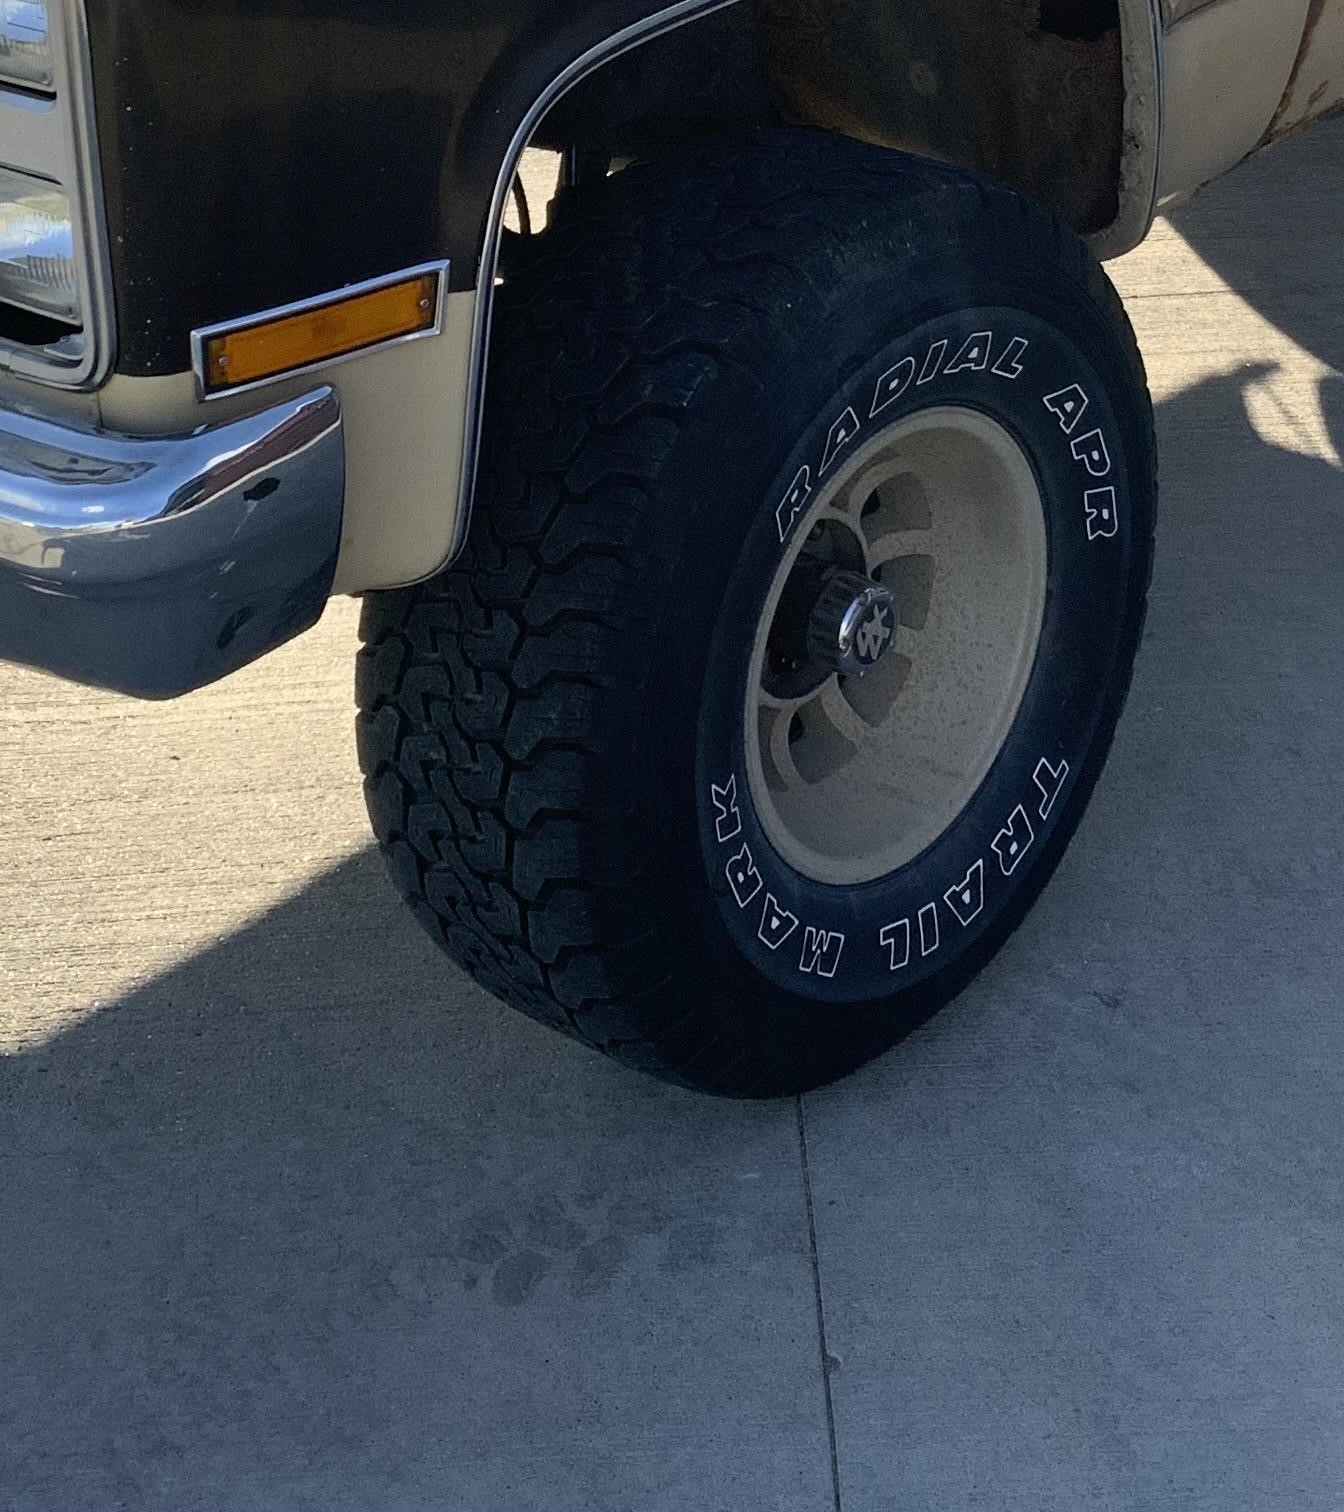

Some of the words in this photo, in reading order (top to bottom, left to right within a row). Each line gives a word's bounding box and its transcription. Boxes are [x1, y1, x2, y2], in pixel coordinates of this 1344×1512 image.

[776, 331, 1029, 543] RADIAL
[1042, 383, 1120, 541] APR
[711, 772, 846, 978] MARK
[878, 756, 1070, 971] TRAIL
